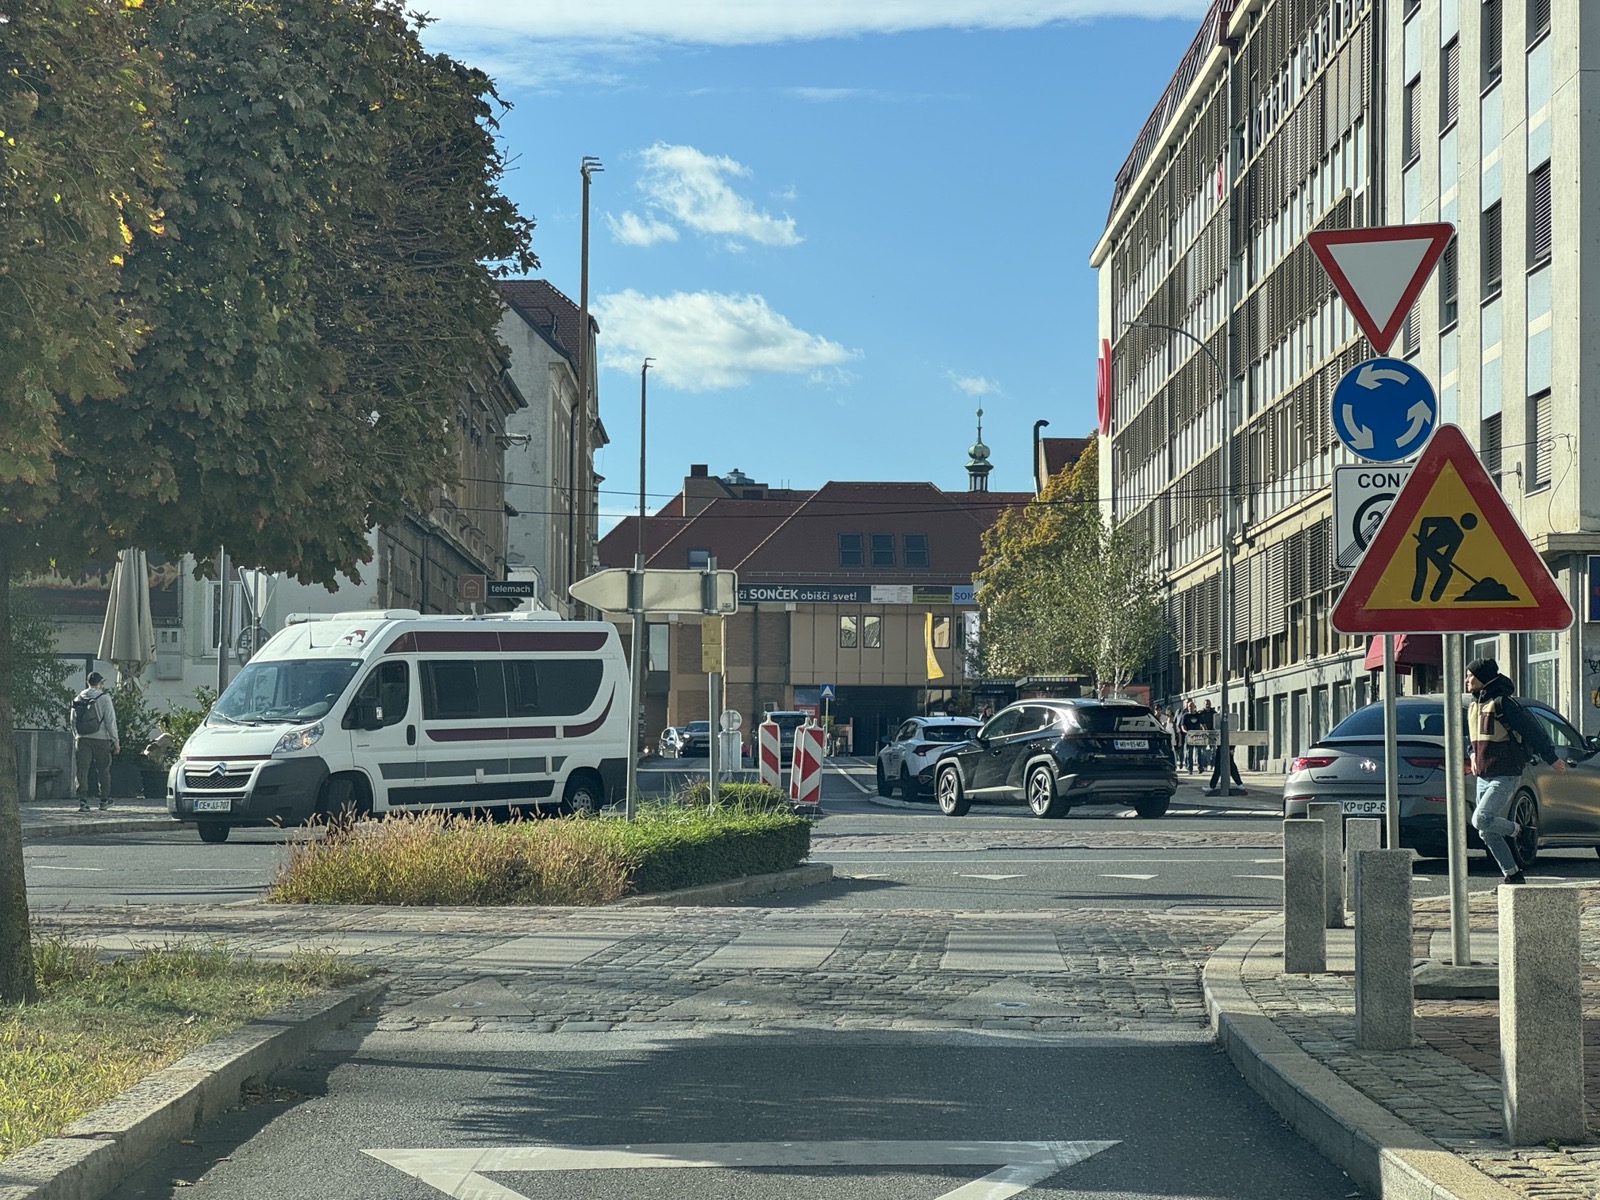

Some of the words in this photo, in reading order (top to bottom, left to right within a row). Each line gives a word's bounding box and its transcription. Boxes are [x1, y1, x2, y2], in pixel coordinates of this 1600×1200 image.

[491, 584, 531, 593] telemach
[738, 589, 747, 599] či
[749, 586, 799, 600] SONČEK
[801, 590, 830, 600] obišči
[832, 591, 857, 601] svet!
[954, 592, 976, 600] SON
[1343, 802, 1356, 812] KP
[1363, 802, 1386, 812] GP-6
